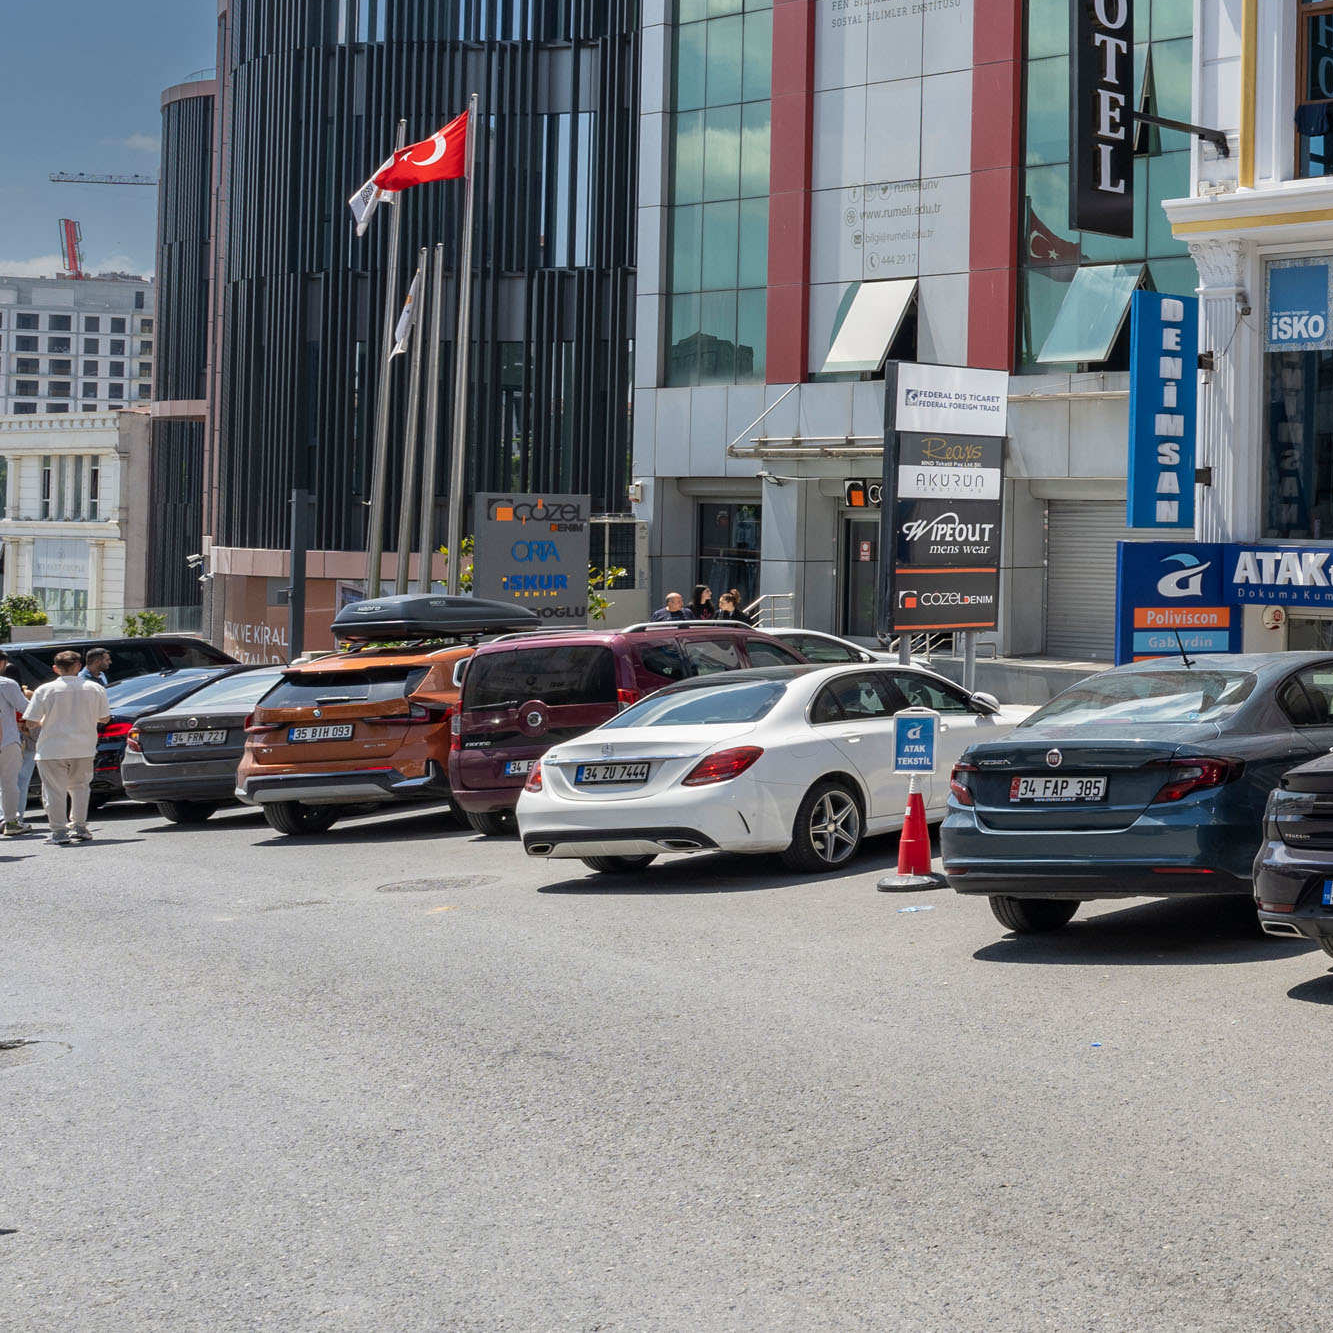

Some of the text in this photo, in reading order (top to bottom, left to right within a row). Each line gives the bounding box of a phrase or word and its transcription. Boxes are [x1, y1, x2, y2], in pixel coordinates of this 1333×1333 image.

[831, 14, 862, 28] SOSYAL
[920, 390, 953, 400] FEDERAL
[969, 394, 1000, 403] TİCARET
[919, 400, 1000, 413] FEDERAL FOREIGN TRADE
[1154, 298, 1184, 523] DENİMSAN
[902, 512, 994, 541] WIPEOUT
[512, 541, 560, 562] ORTA
[929, 545, 990, 554] mens wear
[1232, 551, 1330, 587] ATAK
[1238, 588, 1298, 600] Dokuma
[530, 606, 586, 618] İOĞLU
[1147, 610, 1218, 625] Poliviscon
[254, 621, 288, 646] KİRAL
[1148, 636, 1213, 648] Gabardin
[173, 731, 225, 744] 34 FRN 721
[295, 726, 350, 739] 35 BIH 093
[904, 745, 926, 753] ATAK
[897, 755, 931, 765] TEKSTİL
[511, 762, 521, 772] 34
[585, 765, 648, 780] 34 ZU 7444
[1021, 779, 1036, 796] 34
[1043, 780, 1069, 796] FAP
[1075, 780, 1102, 796] 385
